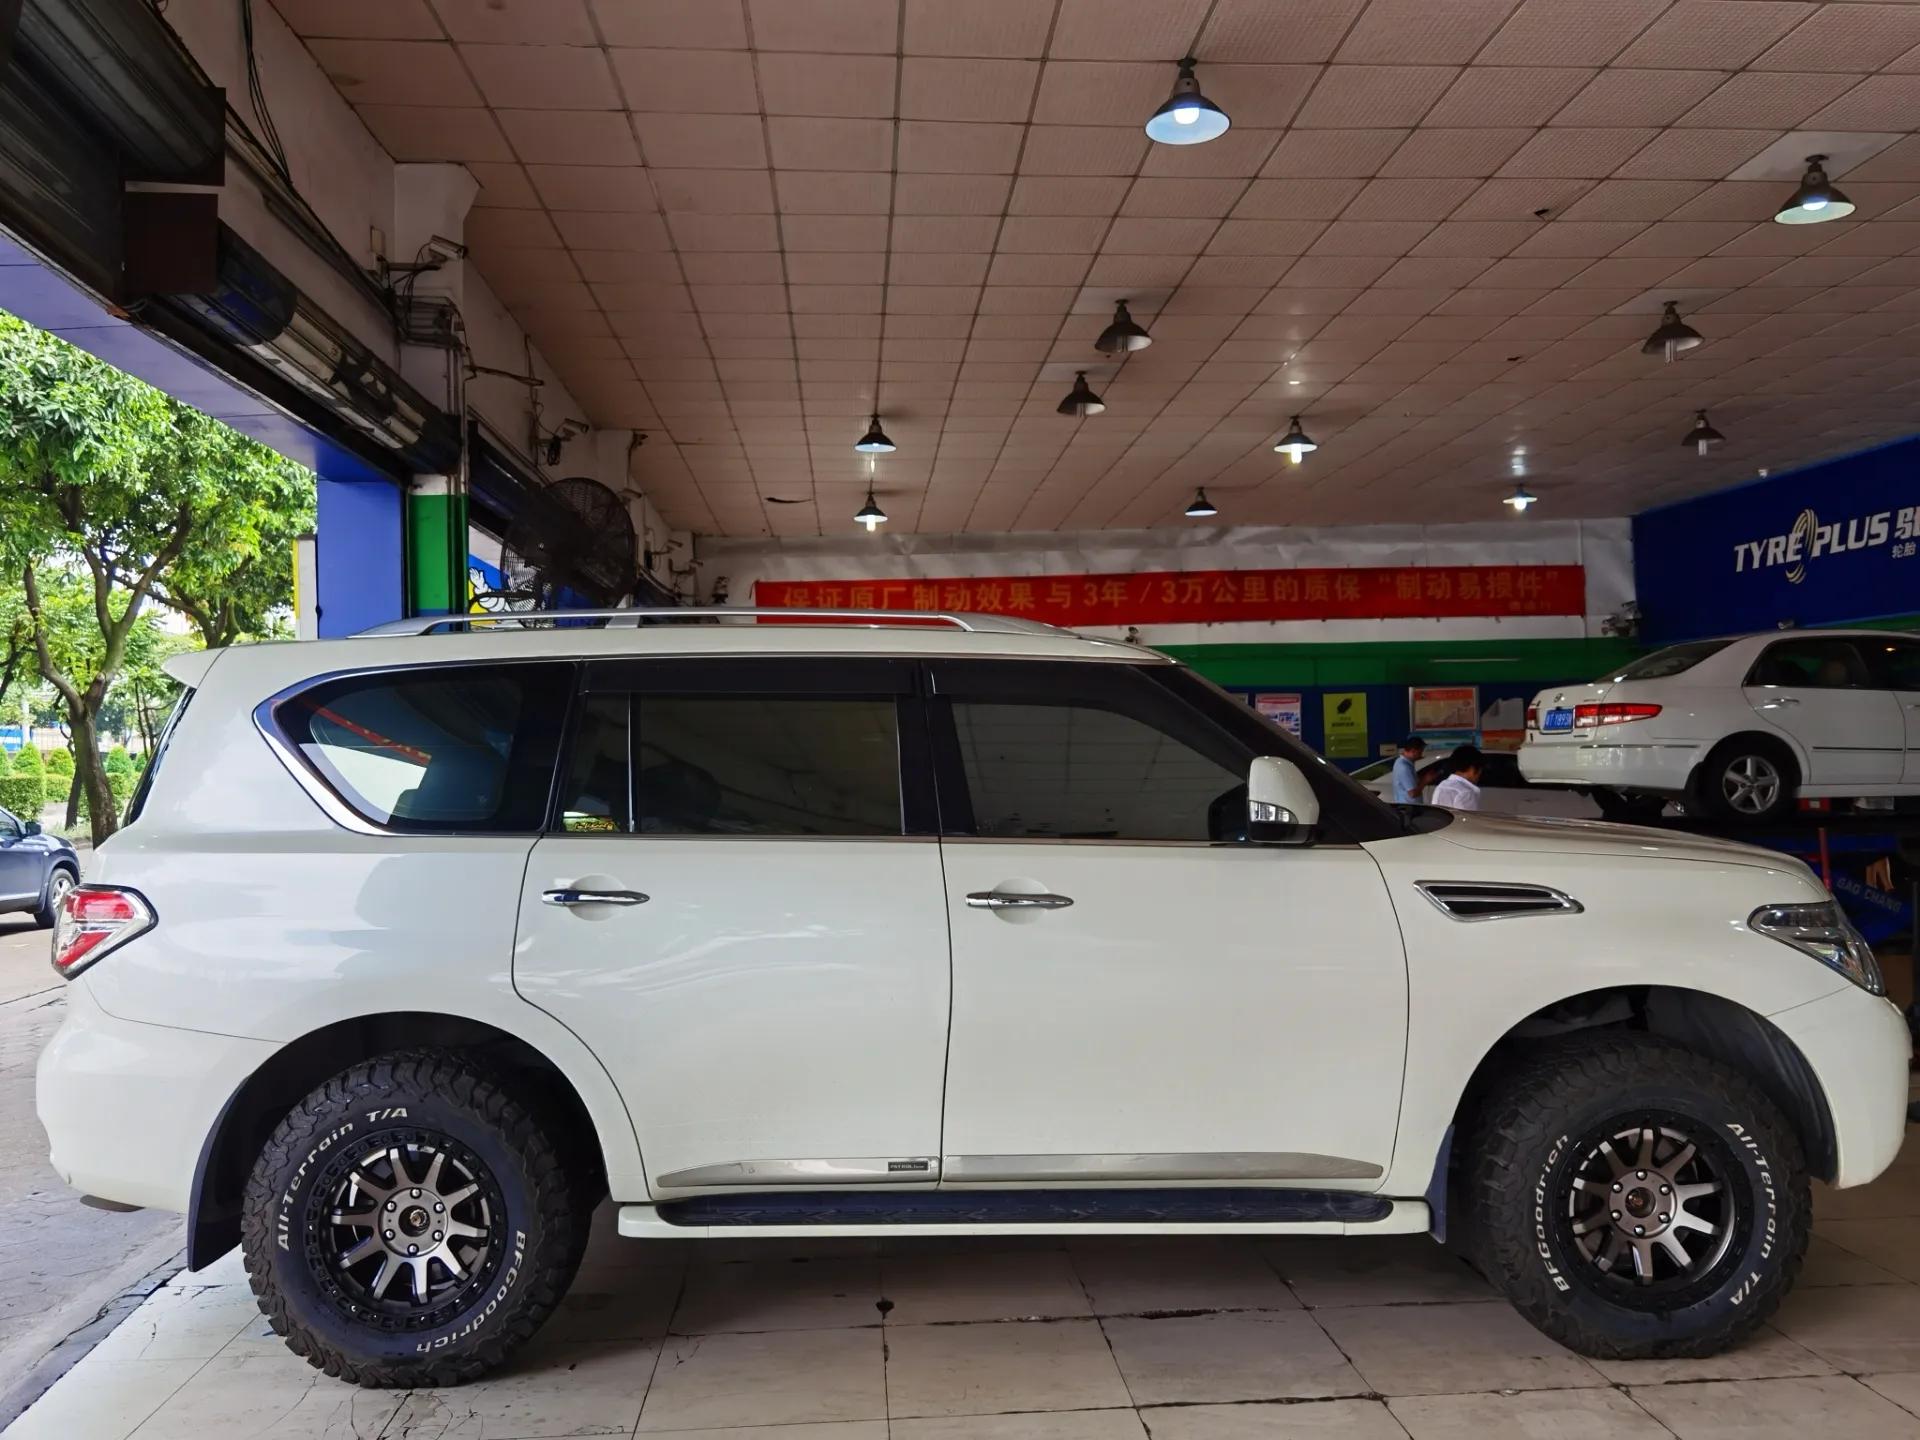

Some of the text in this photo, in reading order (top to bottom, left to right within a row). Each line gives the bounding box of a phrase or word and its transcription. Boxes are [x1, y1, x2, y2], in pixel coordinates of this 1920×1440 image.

[1734, 511, 1891, 573] TYREPLUS
[277, 1107, 408, 1250] All-Terrain T/A
[1535, 1135, 1570, 1292] BFGoodrich
[1726, 1123, 1776, 1305] All-Terrain T/A
[416, 1230, 526, 1353] BFGoodrich
